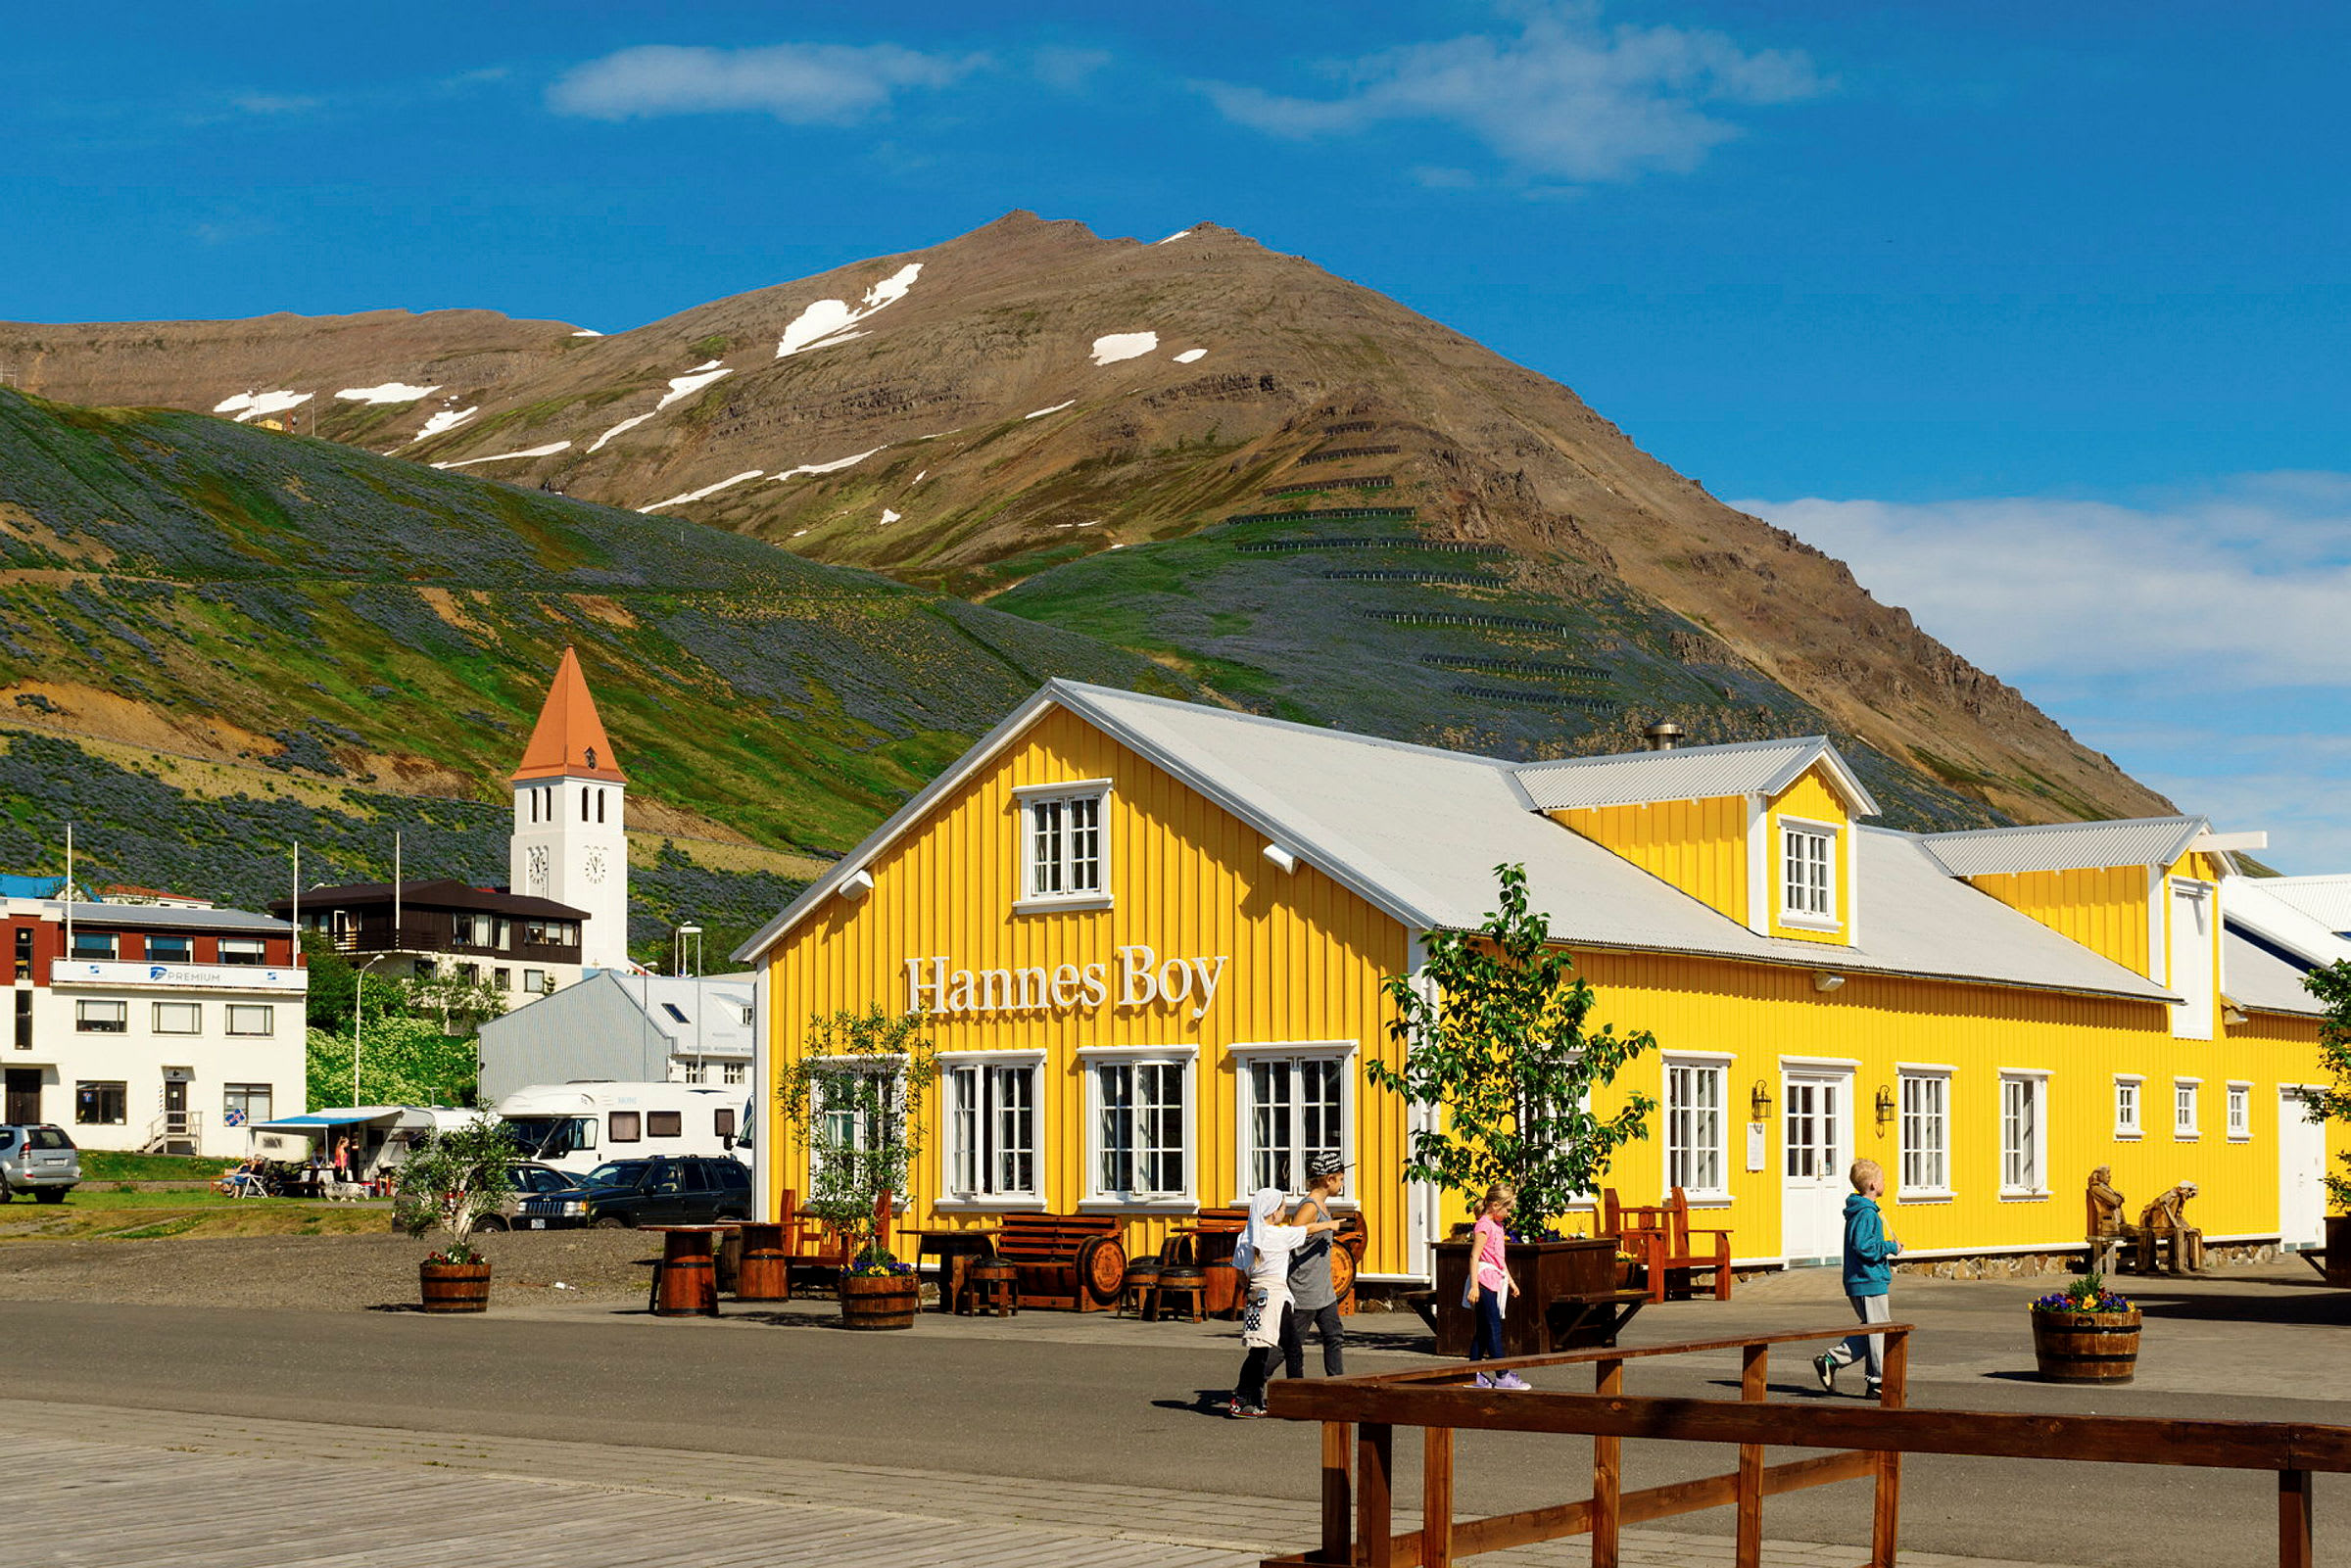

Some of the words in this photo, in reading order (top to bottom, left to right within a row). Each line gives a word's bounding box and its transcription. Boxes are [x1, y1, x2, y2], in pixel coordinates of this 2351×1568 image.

[168, 972, 220, 982] PREMIUM
[904, 955, 1108, 1016] Hannes
[1118, 944, 1229, 1019] Boy
